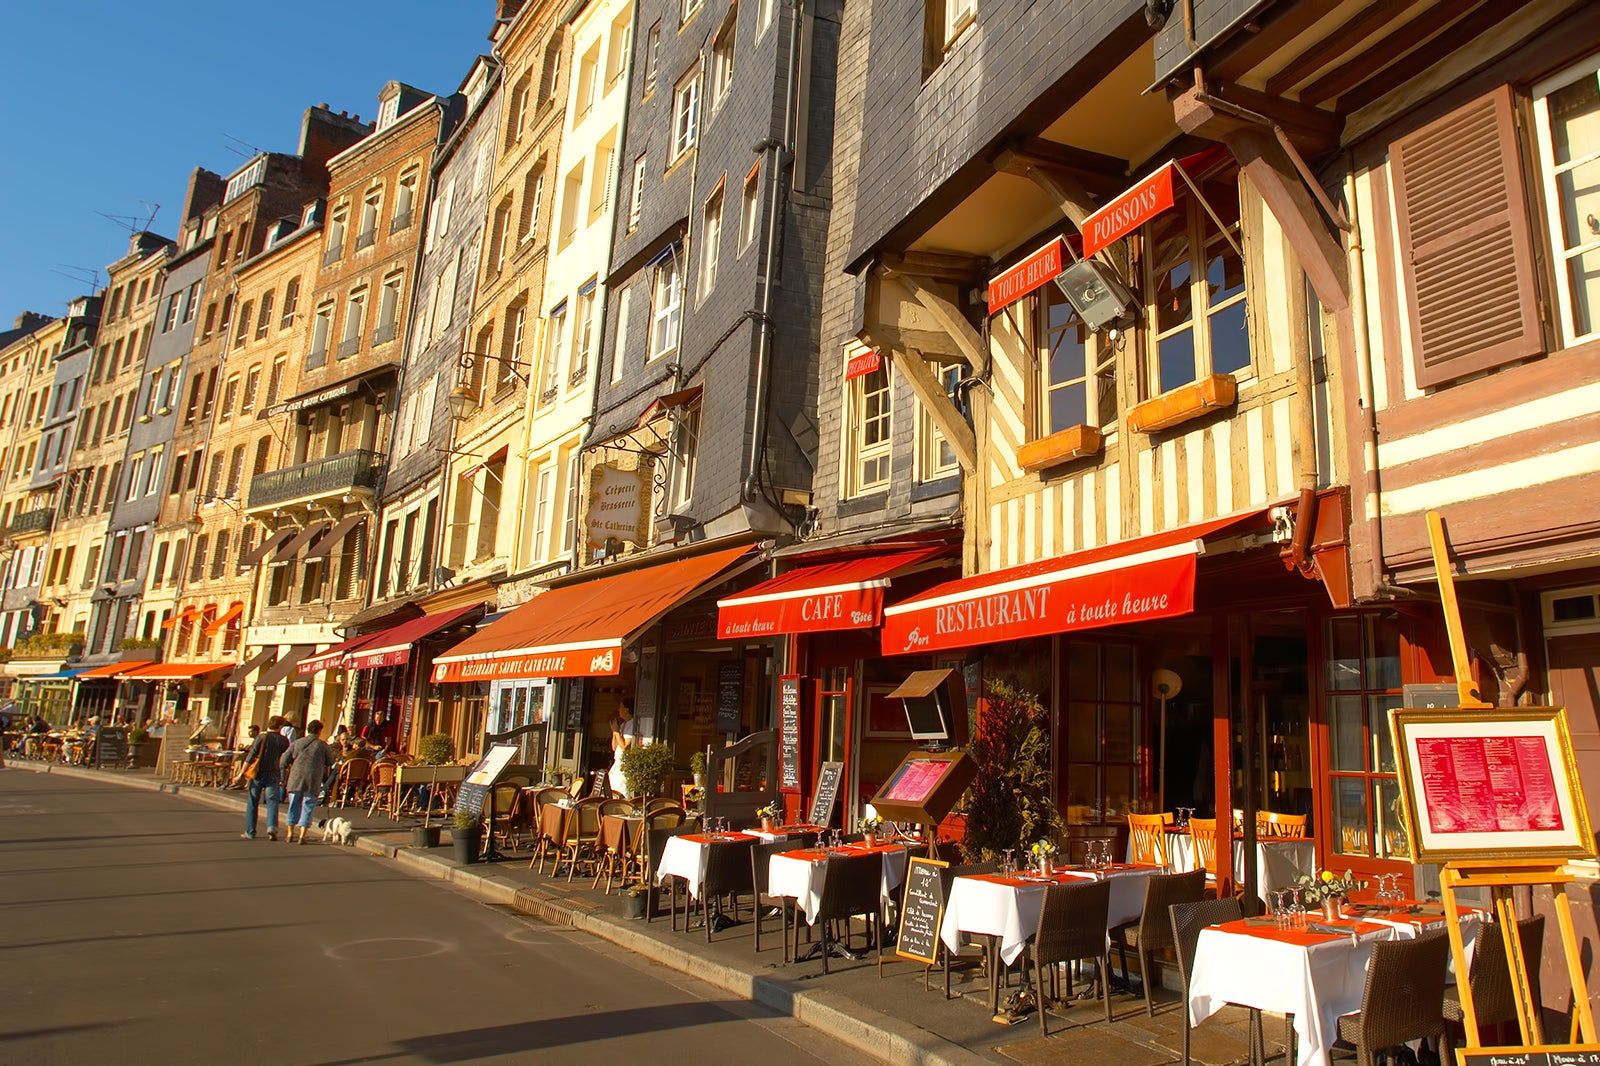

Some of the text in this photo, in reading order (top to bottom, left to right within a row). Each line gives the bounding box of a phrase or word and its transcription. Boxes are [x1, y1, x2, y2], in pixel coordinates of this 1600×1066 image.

[1093, 184, 1157, 245] POISSONS
[998, 269, 1025, 301] TOUTE
[1027, 250, 1057, 285] HEURE
[601, 500, 635, 511] Brasserie
[605, 520, 636, 532] Catherine
[801, 594, 843, 621] CAFE
[936, 586, 1051, 635] RESTAURANT
[1066, 592, 1168, 624] à toute heure
[725, 623, 731, 635] à
[732, 621, 751, 634] toute
[752, 618, 775, 631] heure
[903, 627, 930, 651] Port
[461, 662, 498, 677] RESTAURANT
[498, 660, 522, 674] SAINTE
[524, 657, 566, 672] CATHERINE
